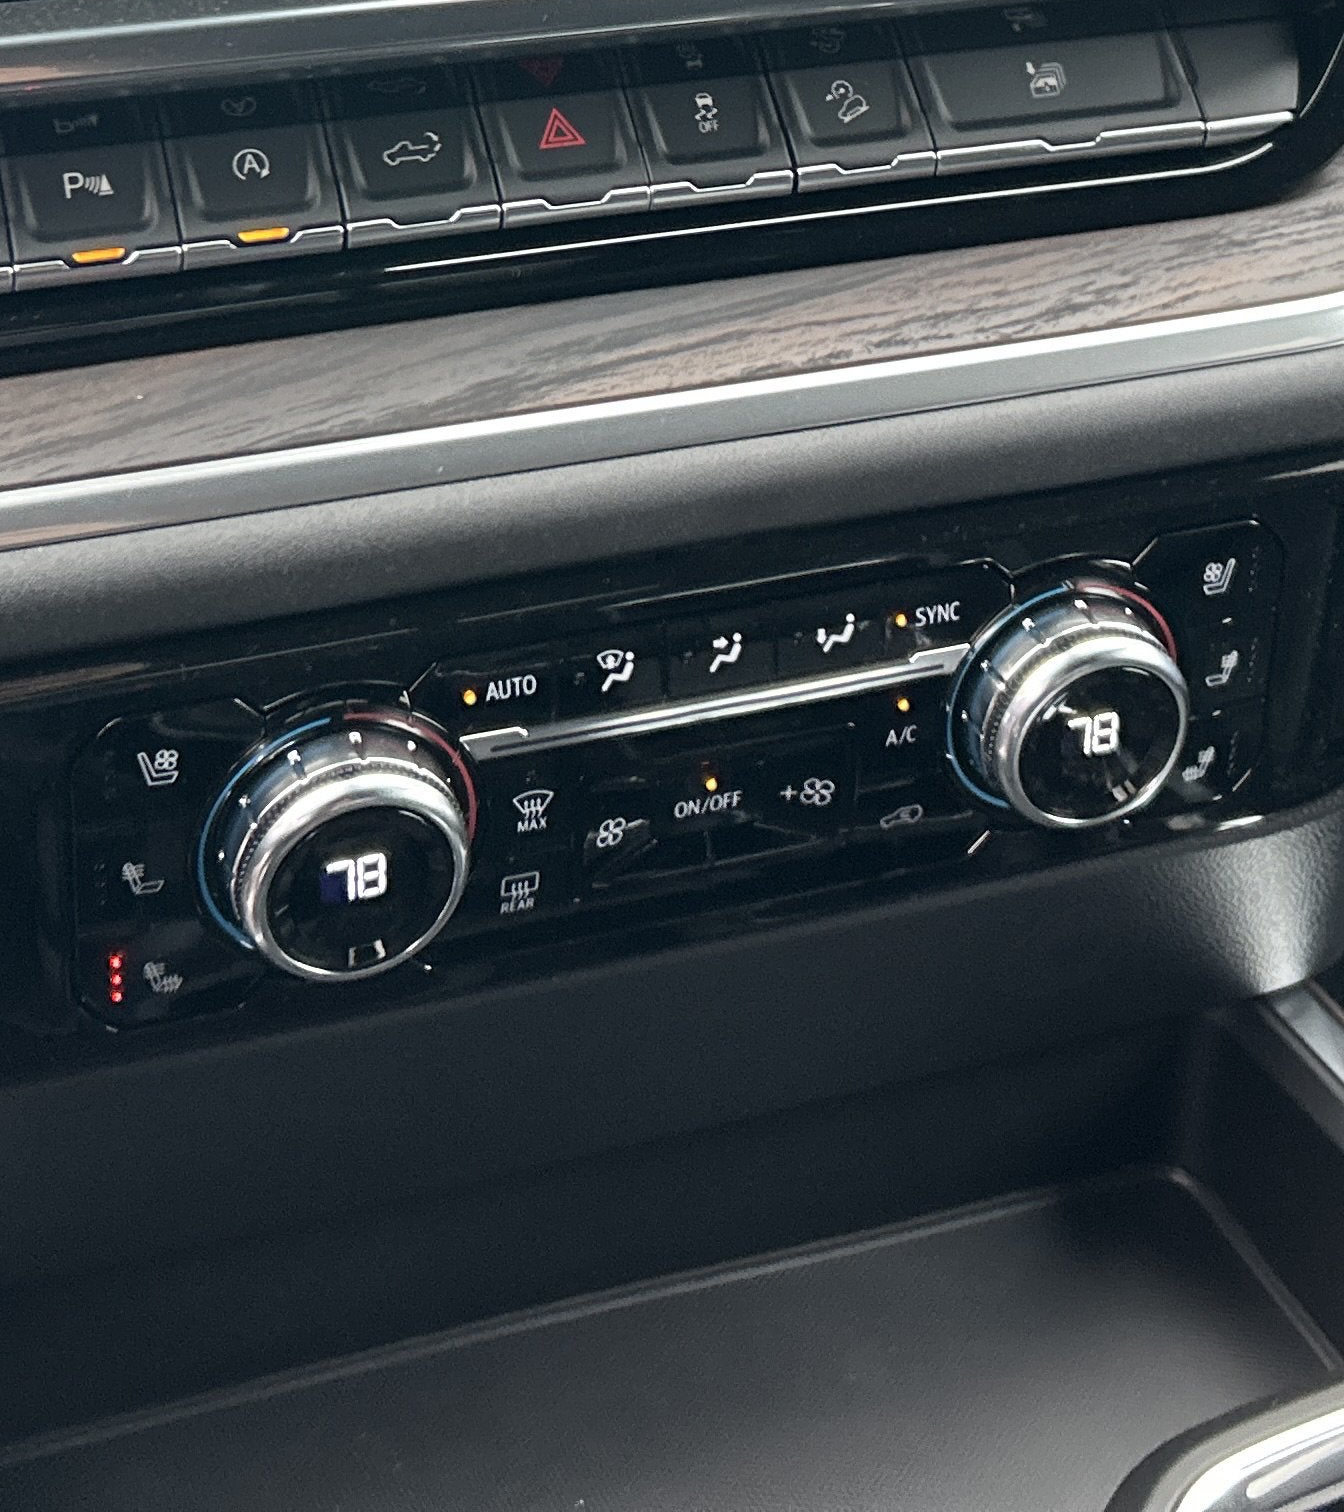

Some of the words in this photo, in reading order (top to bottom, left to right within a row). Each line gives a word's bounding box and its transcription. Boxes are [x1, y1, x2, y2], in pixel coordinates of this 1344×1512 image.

[915, 601, 960, 627] SYNC
[486, 675, 536, 701] AUTO
[886, 725, 916, 746] A/C
[1069, 712, 1119, 756] 78
[674, 790, 742, 818] ON/OFF
[517, 816, 547, 833] MAX
[326, 852, 387, 901] 78
[500, 897, 535, 915] REAR
